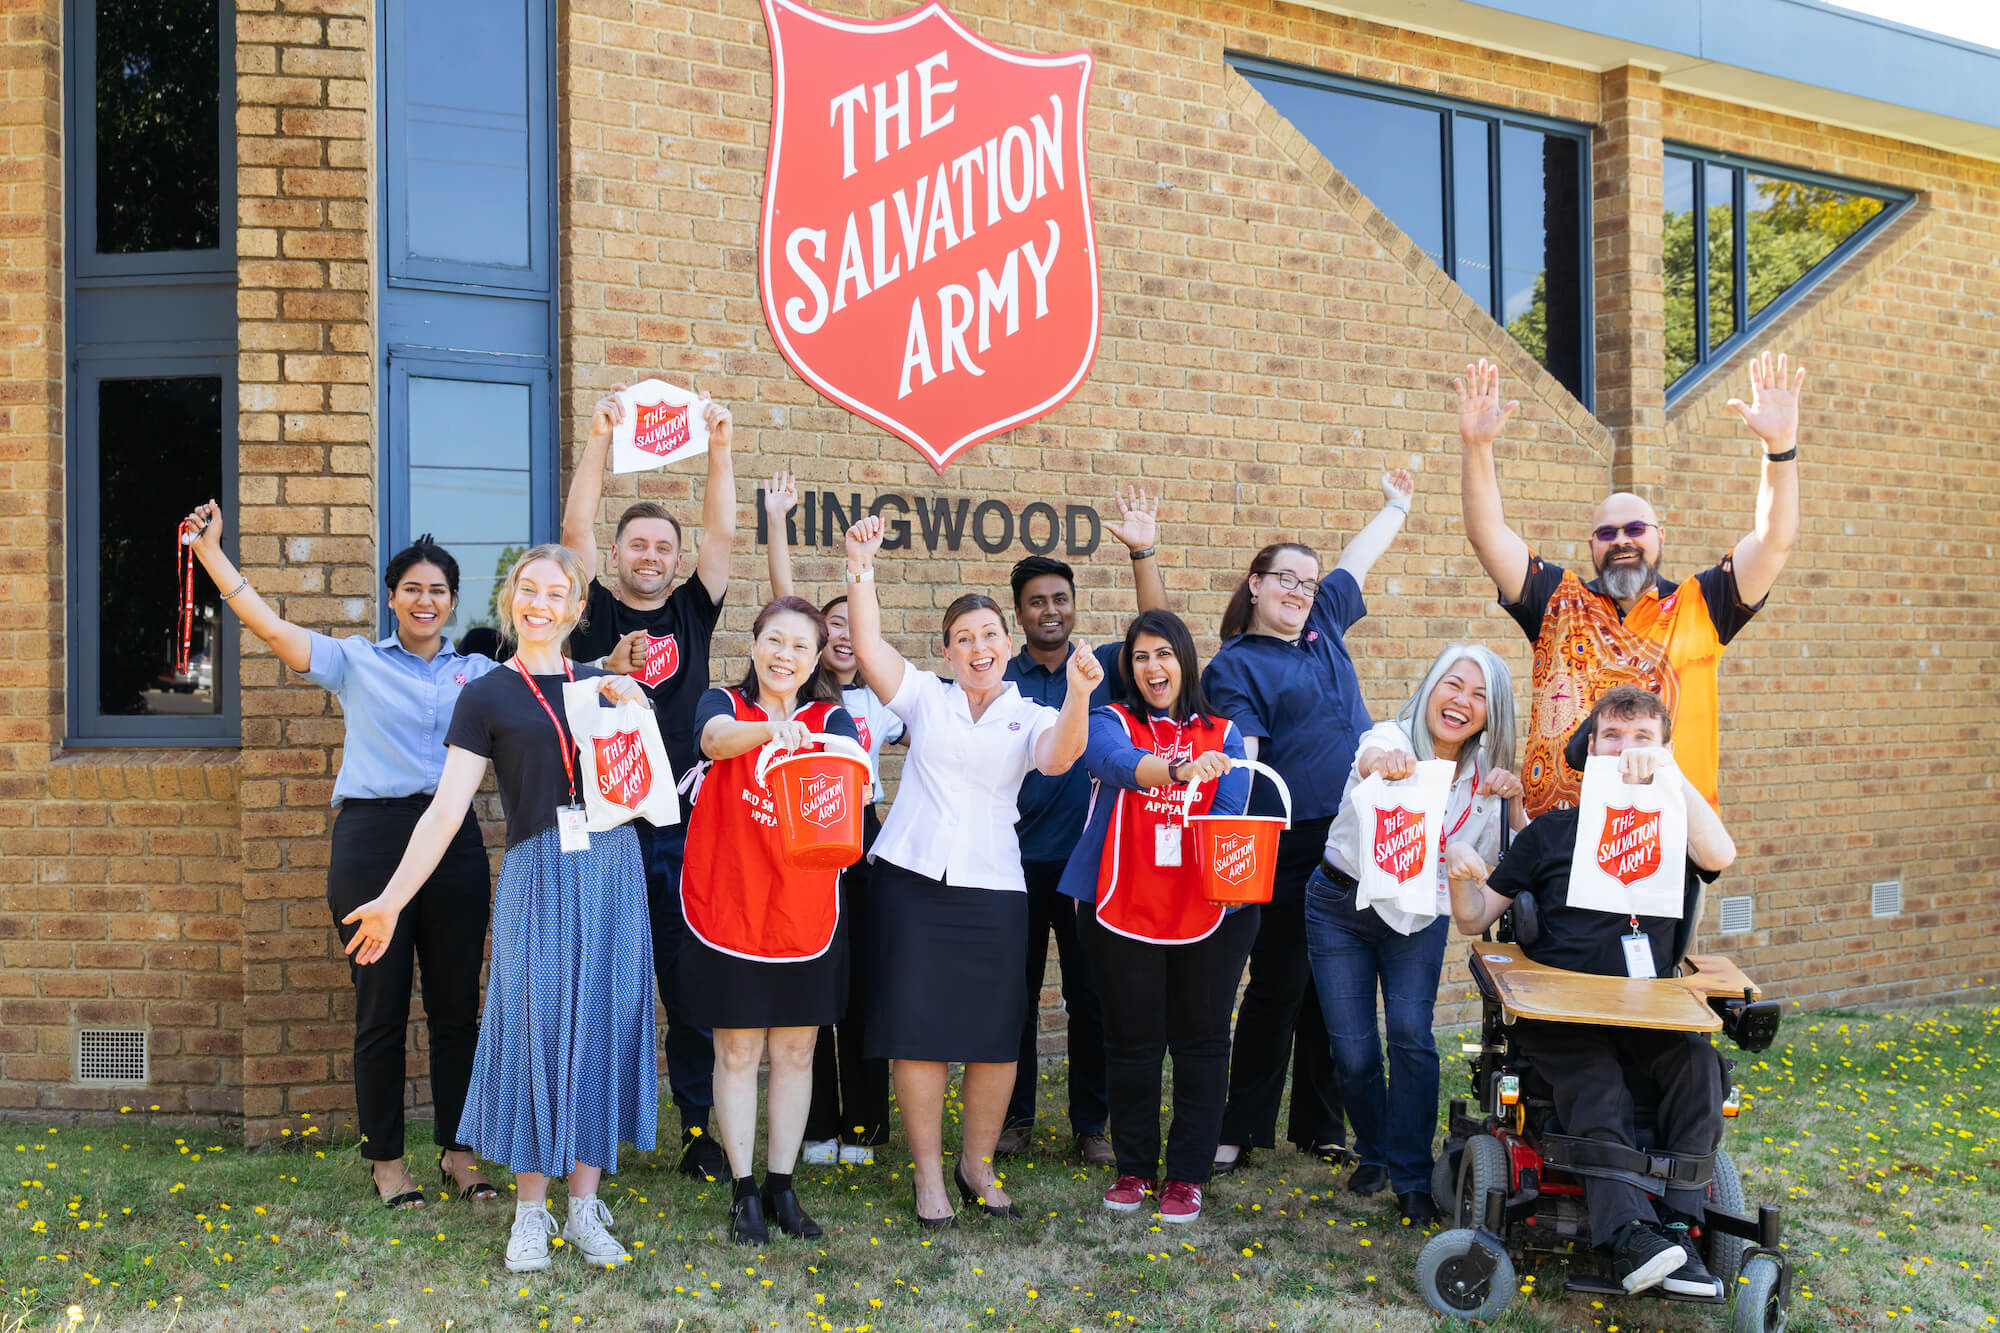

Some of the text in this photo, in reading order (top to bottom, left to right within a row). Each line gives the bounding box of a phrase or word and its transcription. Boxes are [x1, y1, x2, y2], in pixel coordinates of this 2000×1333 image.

[830, 50, 958, 180] THE
[784, 93, 1065, 335] SALVATION
[897, 219, 1061, 400] ARMY
[636, 410, 688, 447] SALVATION
[644, 405, 667, 429] THE
[655, 430, 685, 453] ARMY
[645, 647, 672, 681] ARMY
[603, 735, 626, 765] THE
[623, 759, 645, 804] ARMY
[808, 778, 826, 797] THE
[1161, 790, 1203, 802] SHIED
[803, 781, 841, 816] SALVATION
[818, 797, 840, 823] ARMY
[1384, 811, 1404, 835] THE
[1611, 810, 1635, 835] THE
[1221, 838, 1238, 854] THE
[1376, 817, 1424, 863] SAVATION
[1598, 816, 1658, 863] SALVATION
[1216, 840, 1252, 871] SALVATION
[1228, 855, 1251, 879] ARMY
[1617, 840, 1656, 877] ARMY
